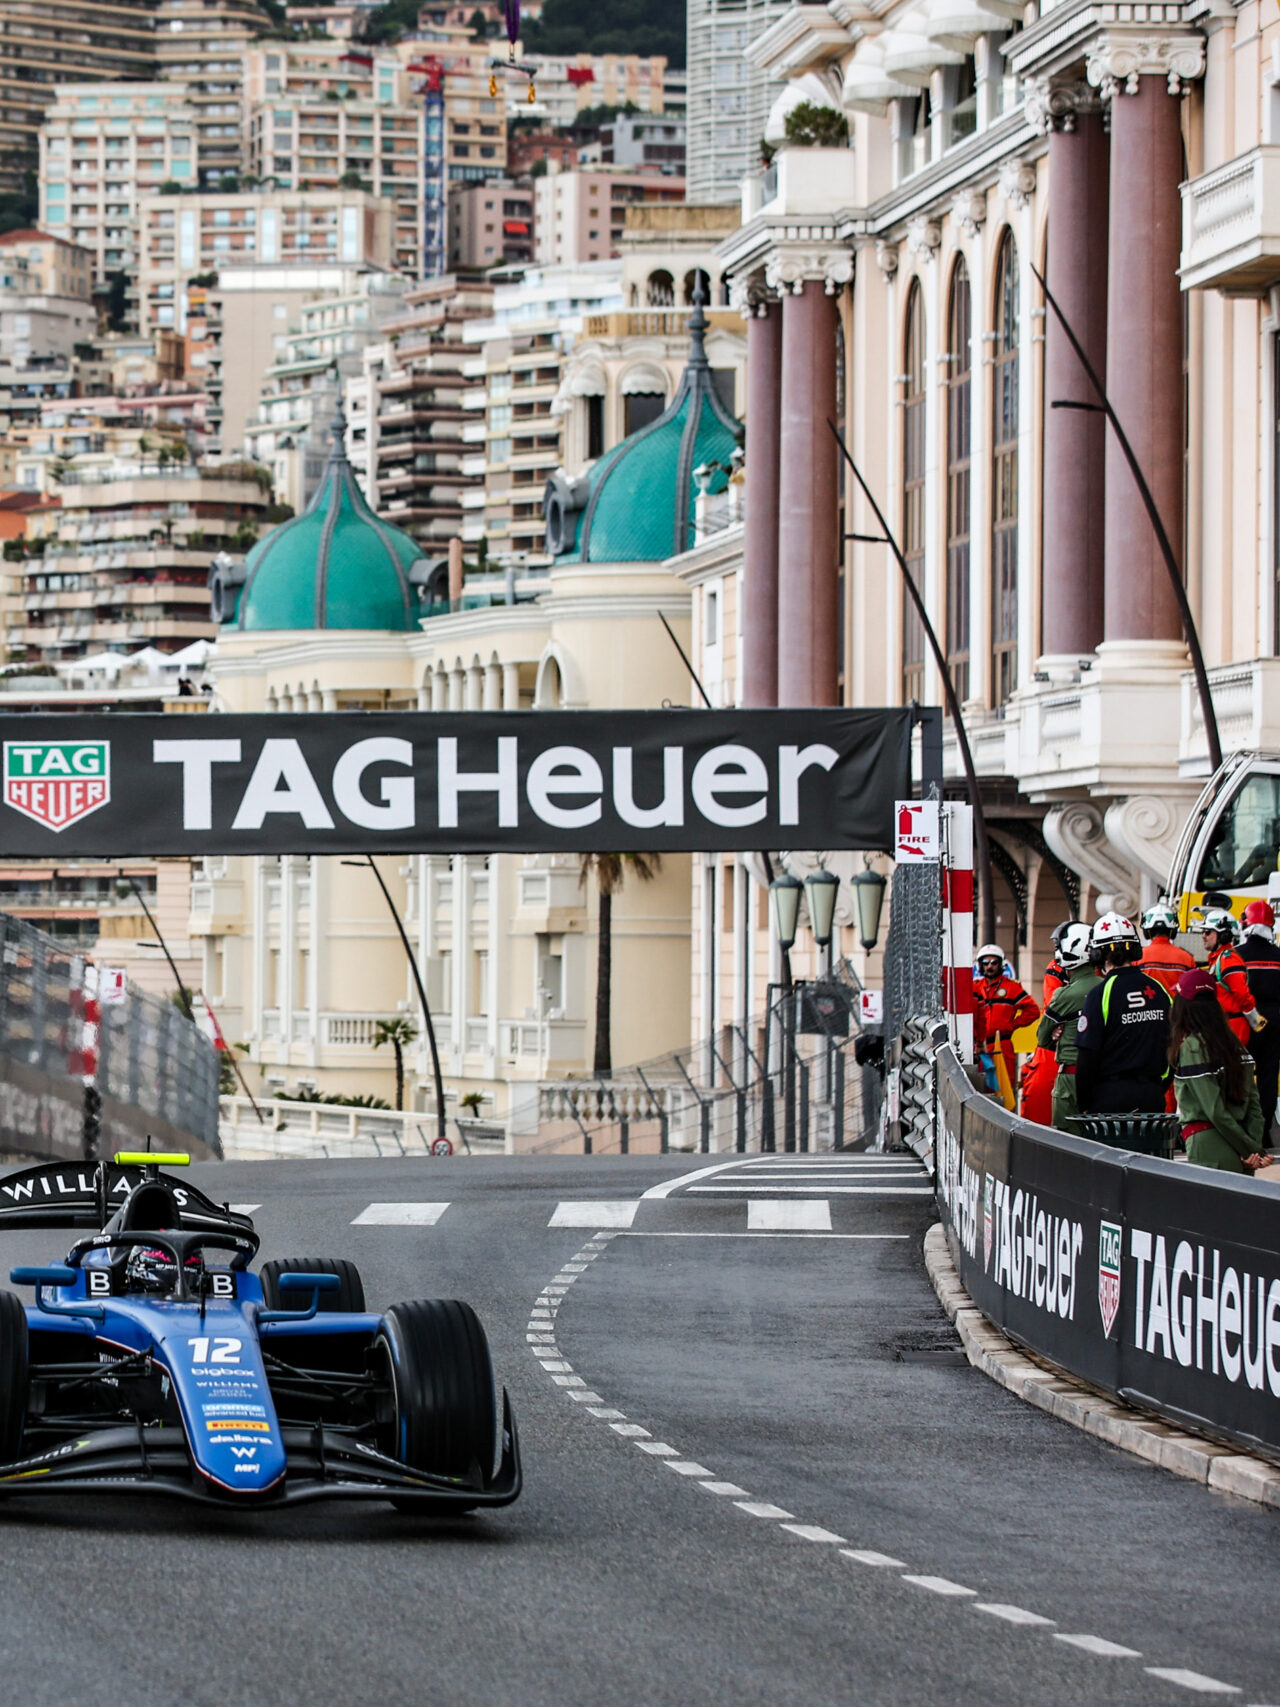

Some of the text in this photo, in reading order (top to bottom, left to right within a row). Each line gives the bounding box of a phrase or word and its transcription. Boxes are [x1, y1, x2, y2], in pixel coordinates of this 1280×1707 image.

[12, 747, 100, 774] TAG
[11, 781, 104, 824] HEUER
[1121, 1009, 1164, 1025] SECOURISTE
[1, 1173, 189, 1206] WILLAS
[1102, 1229, 1120, 1267] TAG
[90, 1271, 111, 1292] B
[213, 1274, 234, 1294] B
[187, 1337, 243, 1363] 12
[191, 1367, 255, 1377] bigbox
[196, 1381, 259, 1389] WILLIAMS
[209, 1434, 273, 1445] dallara
[230, 1446, 257, 1459] W
